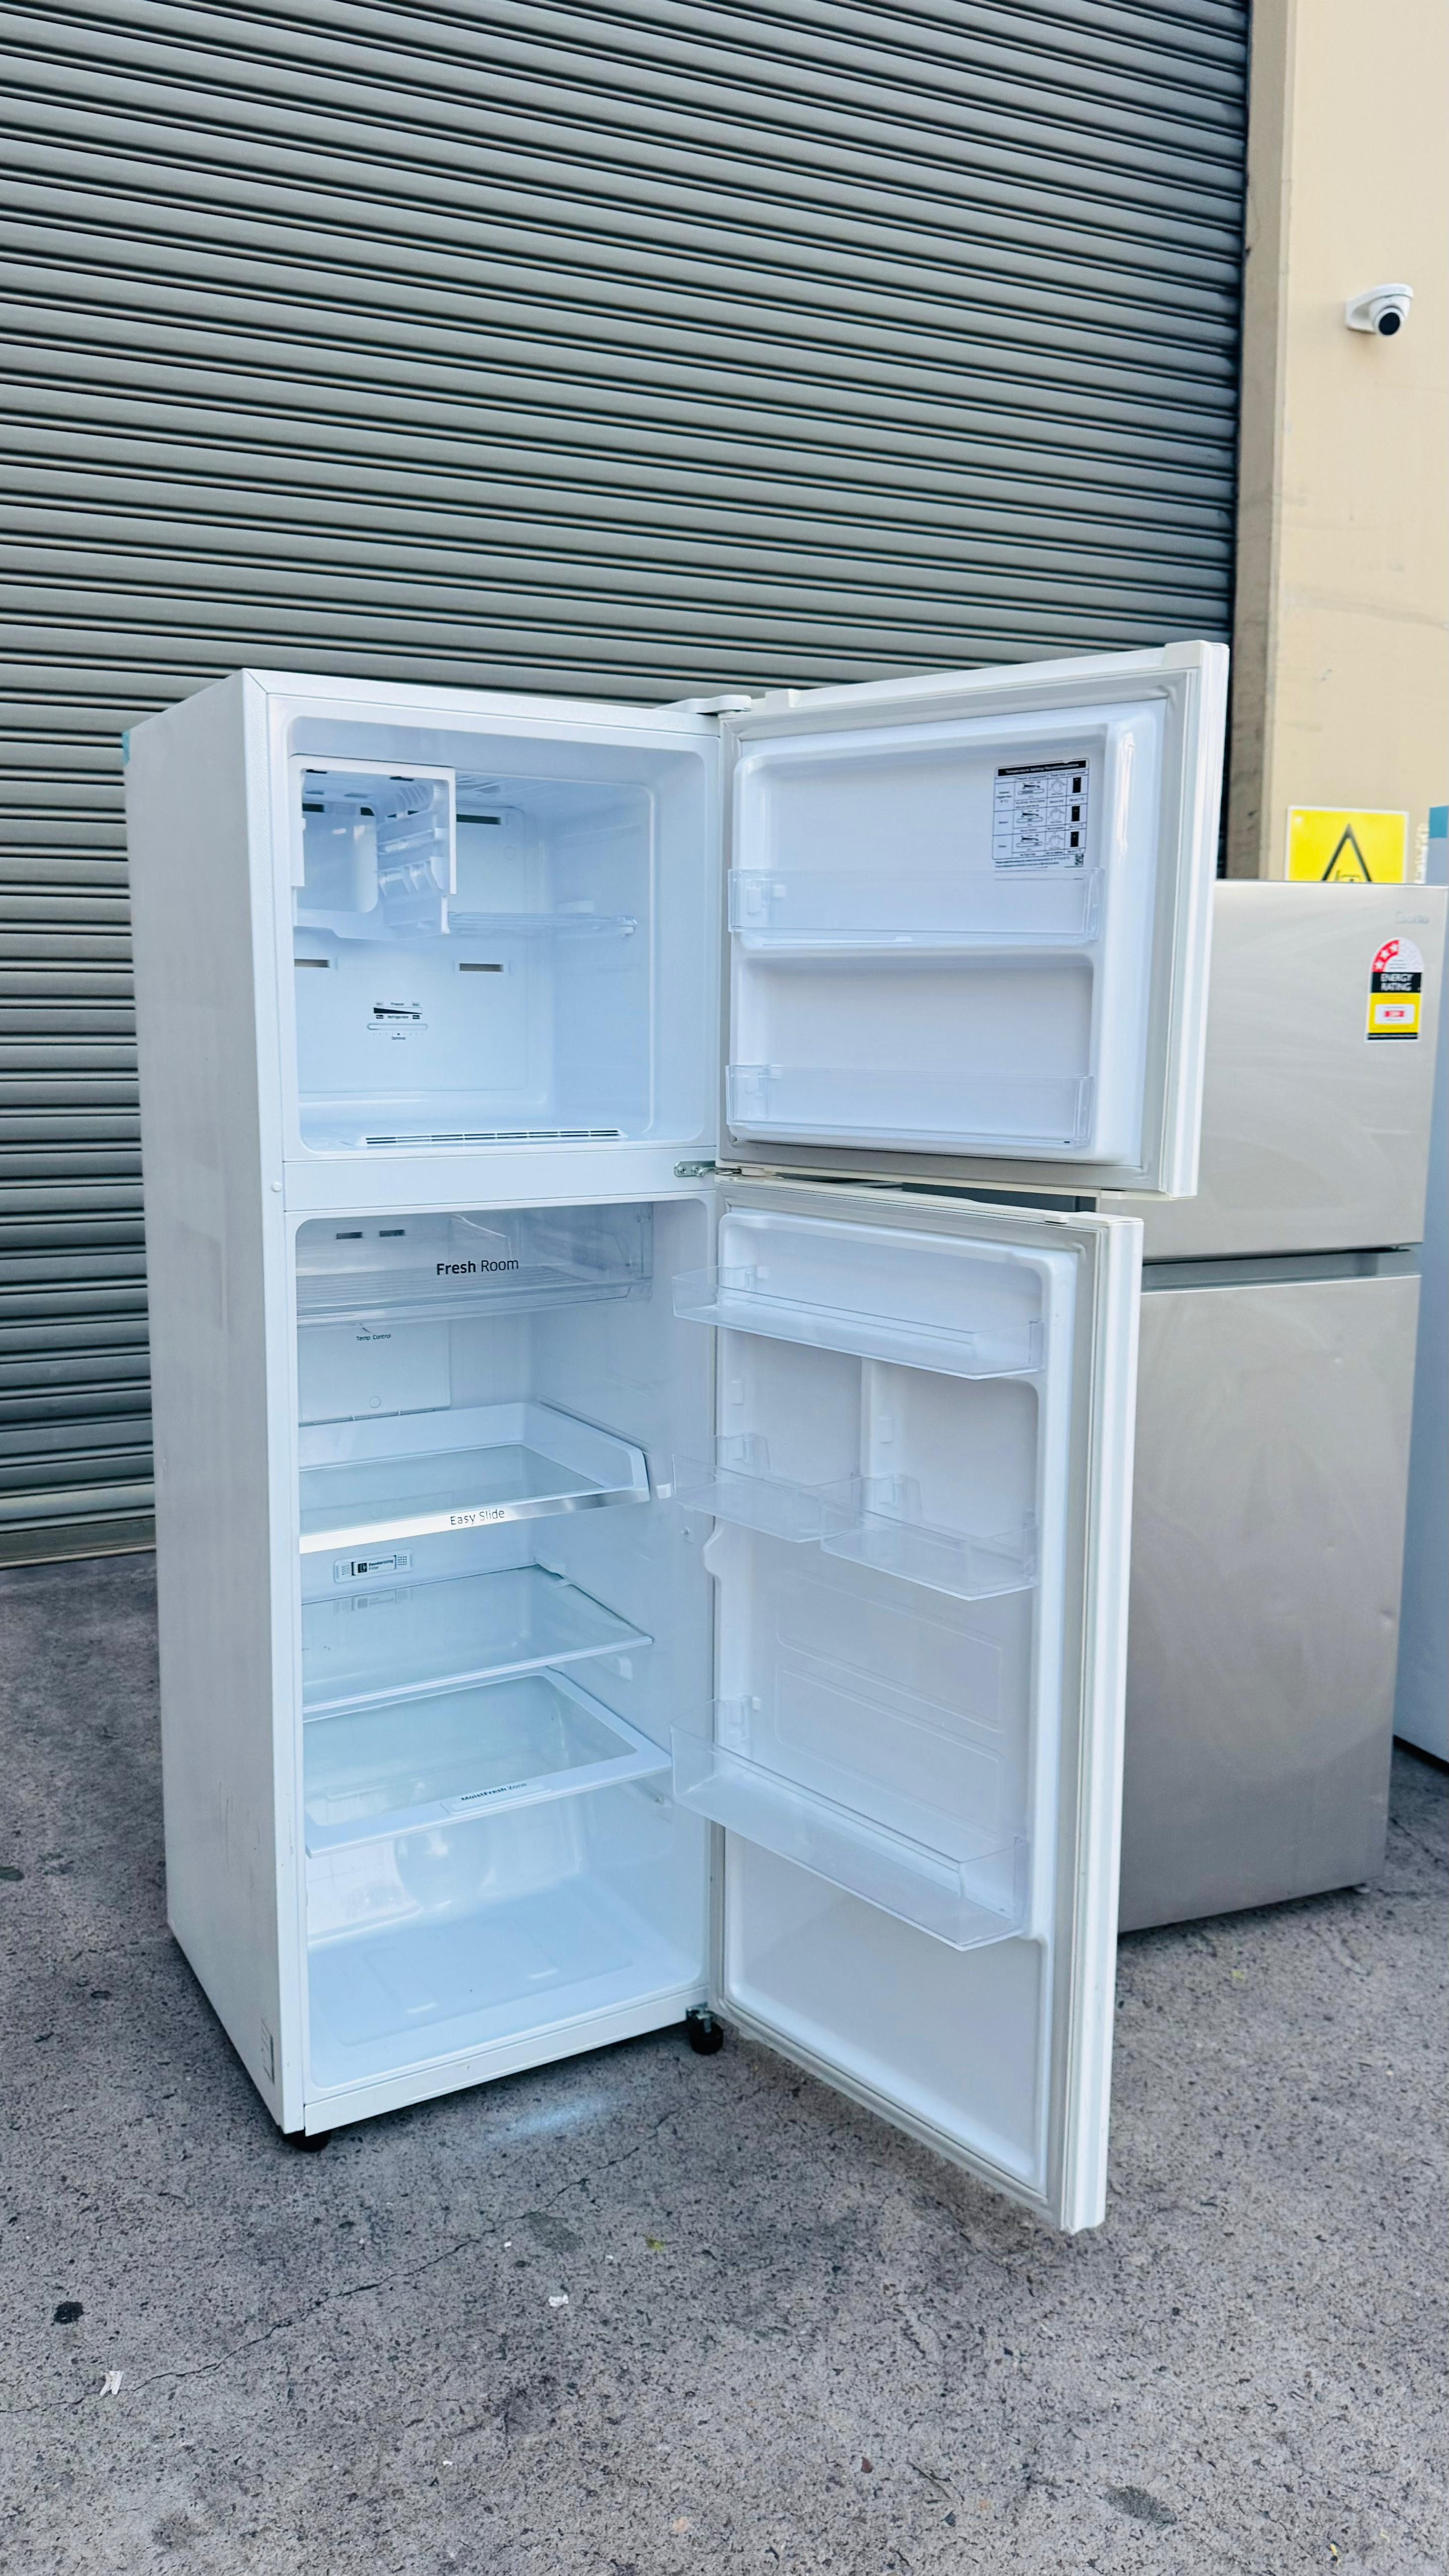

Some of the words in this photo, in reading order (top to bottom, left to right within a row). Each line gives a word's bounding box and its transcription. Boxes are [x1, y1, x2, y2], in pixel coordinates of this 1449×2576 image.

[1380, 973, 1414, 982] ENERGY
[1380, 982, 1412, 991] RATING
[437, 1261, 476, 1275] Fresh
[481, 1260, 519, 1272] Room
[450, 1514, 475, 1525] Easy
[479, 1509, 505, 1521] Slide
